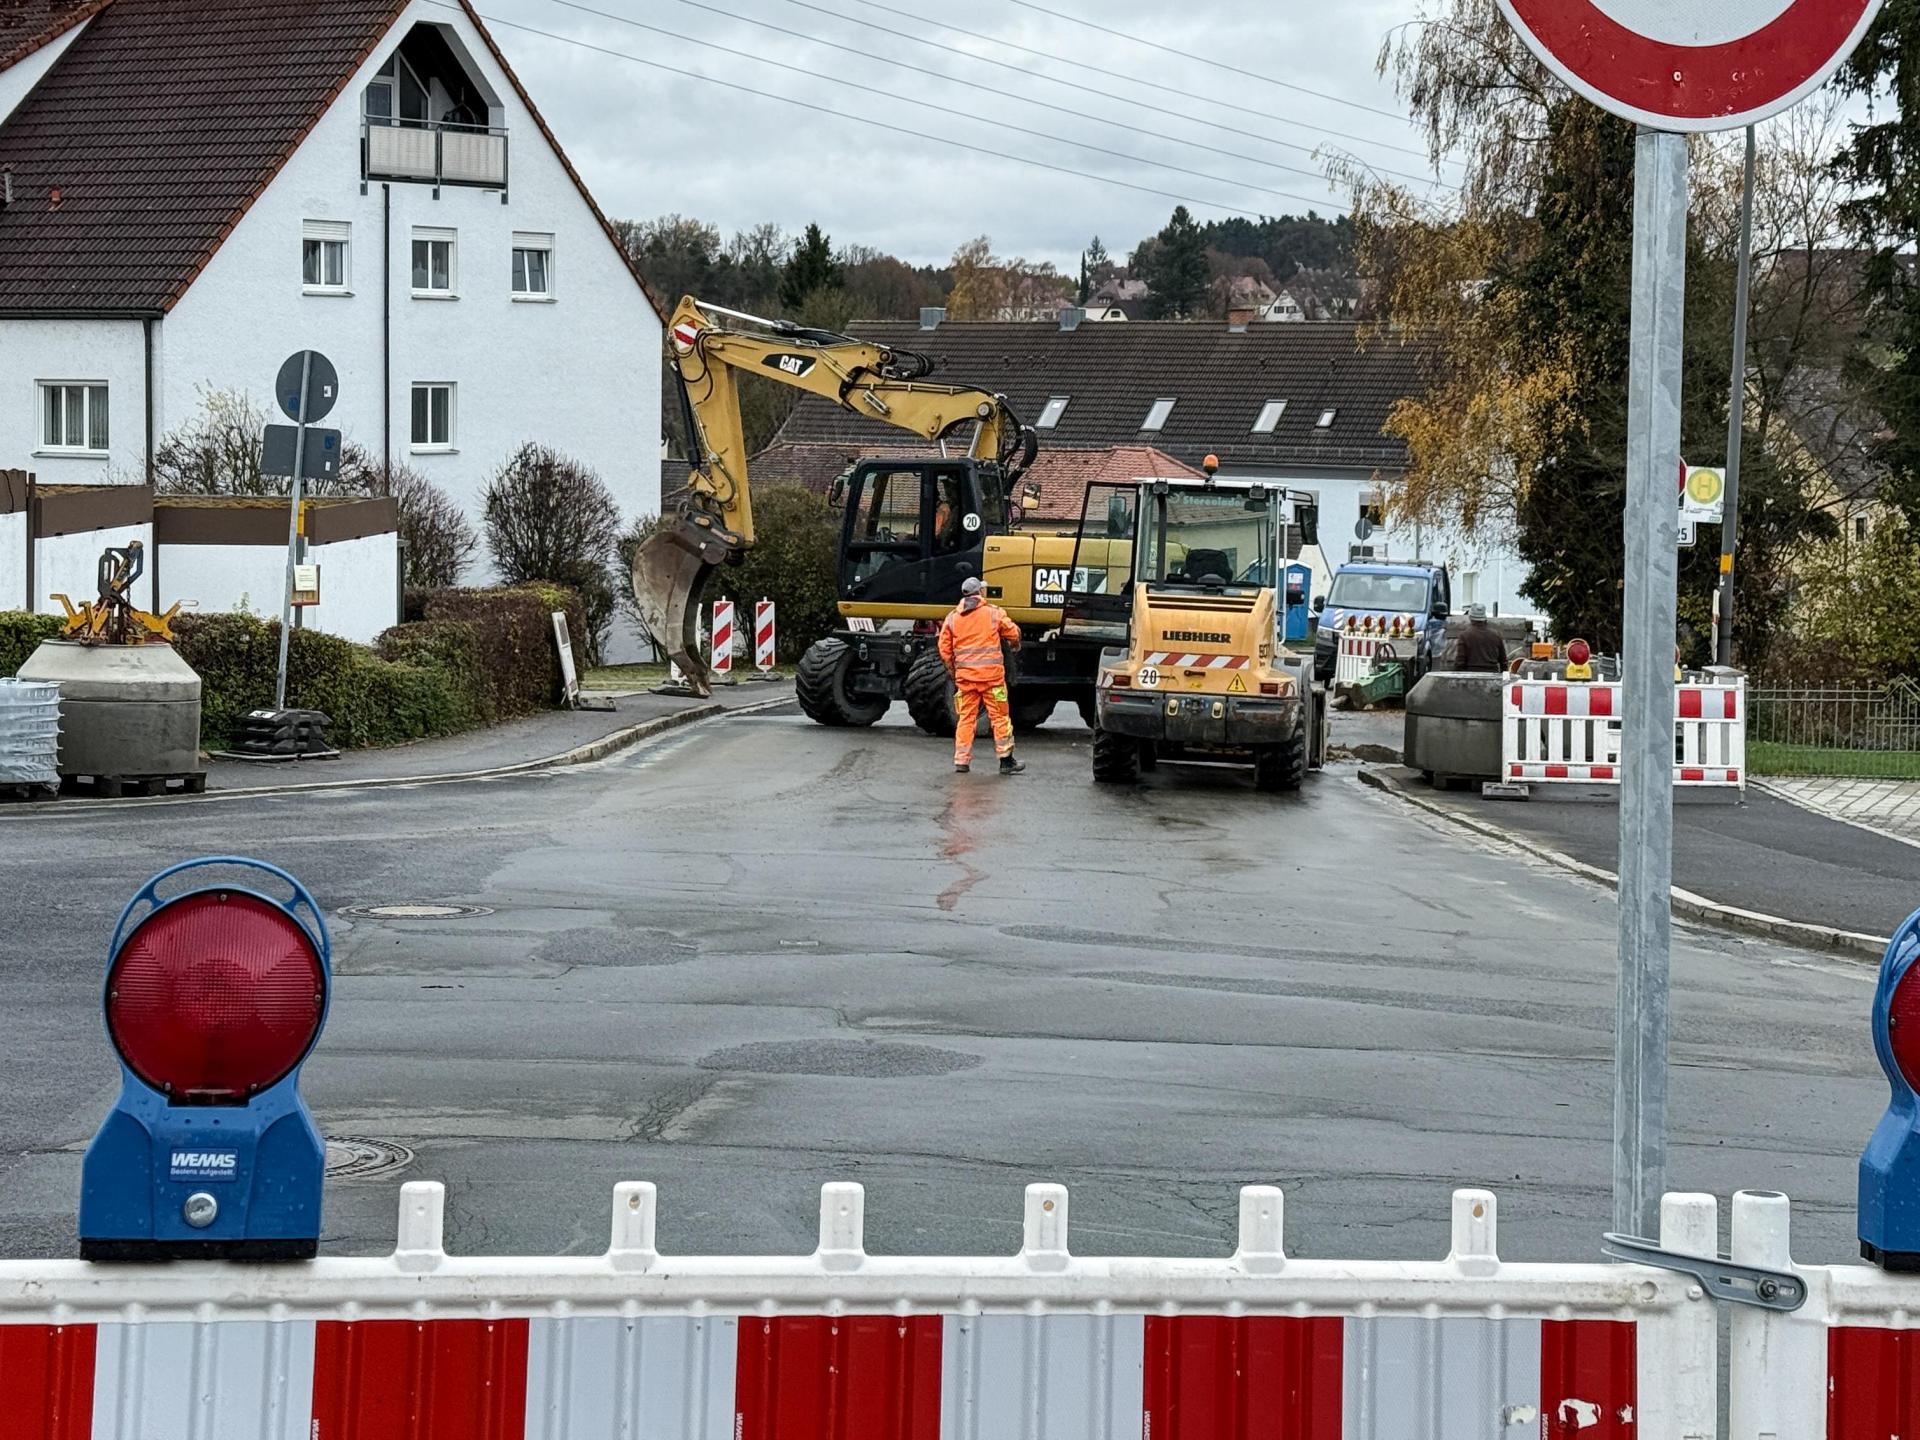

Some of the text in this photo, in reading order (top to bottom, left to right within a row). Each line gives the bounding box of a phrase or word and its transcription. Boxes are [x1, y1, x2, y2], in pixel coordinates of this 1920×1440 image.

[779, 355, 803, 374] CAT
[1697, 476, 1712, 496] H
[966, 516, 977, 528] 20
[1035, 568, 1070, 592] CAT
[1035, 593, 1065, 604] M316D
[1162, 630, 1231, 643] LIEBHERR
[1142, 669, 1157, 684] 20
[171, 1153, 236, 1168] WEMAS
[312, 1418, 320, 1440] WEM
[1541, 1413, 1549, 1440] WEMA
